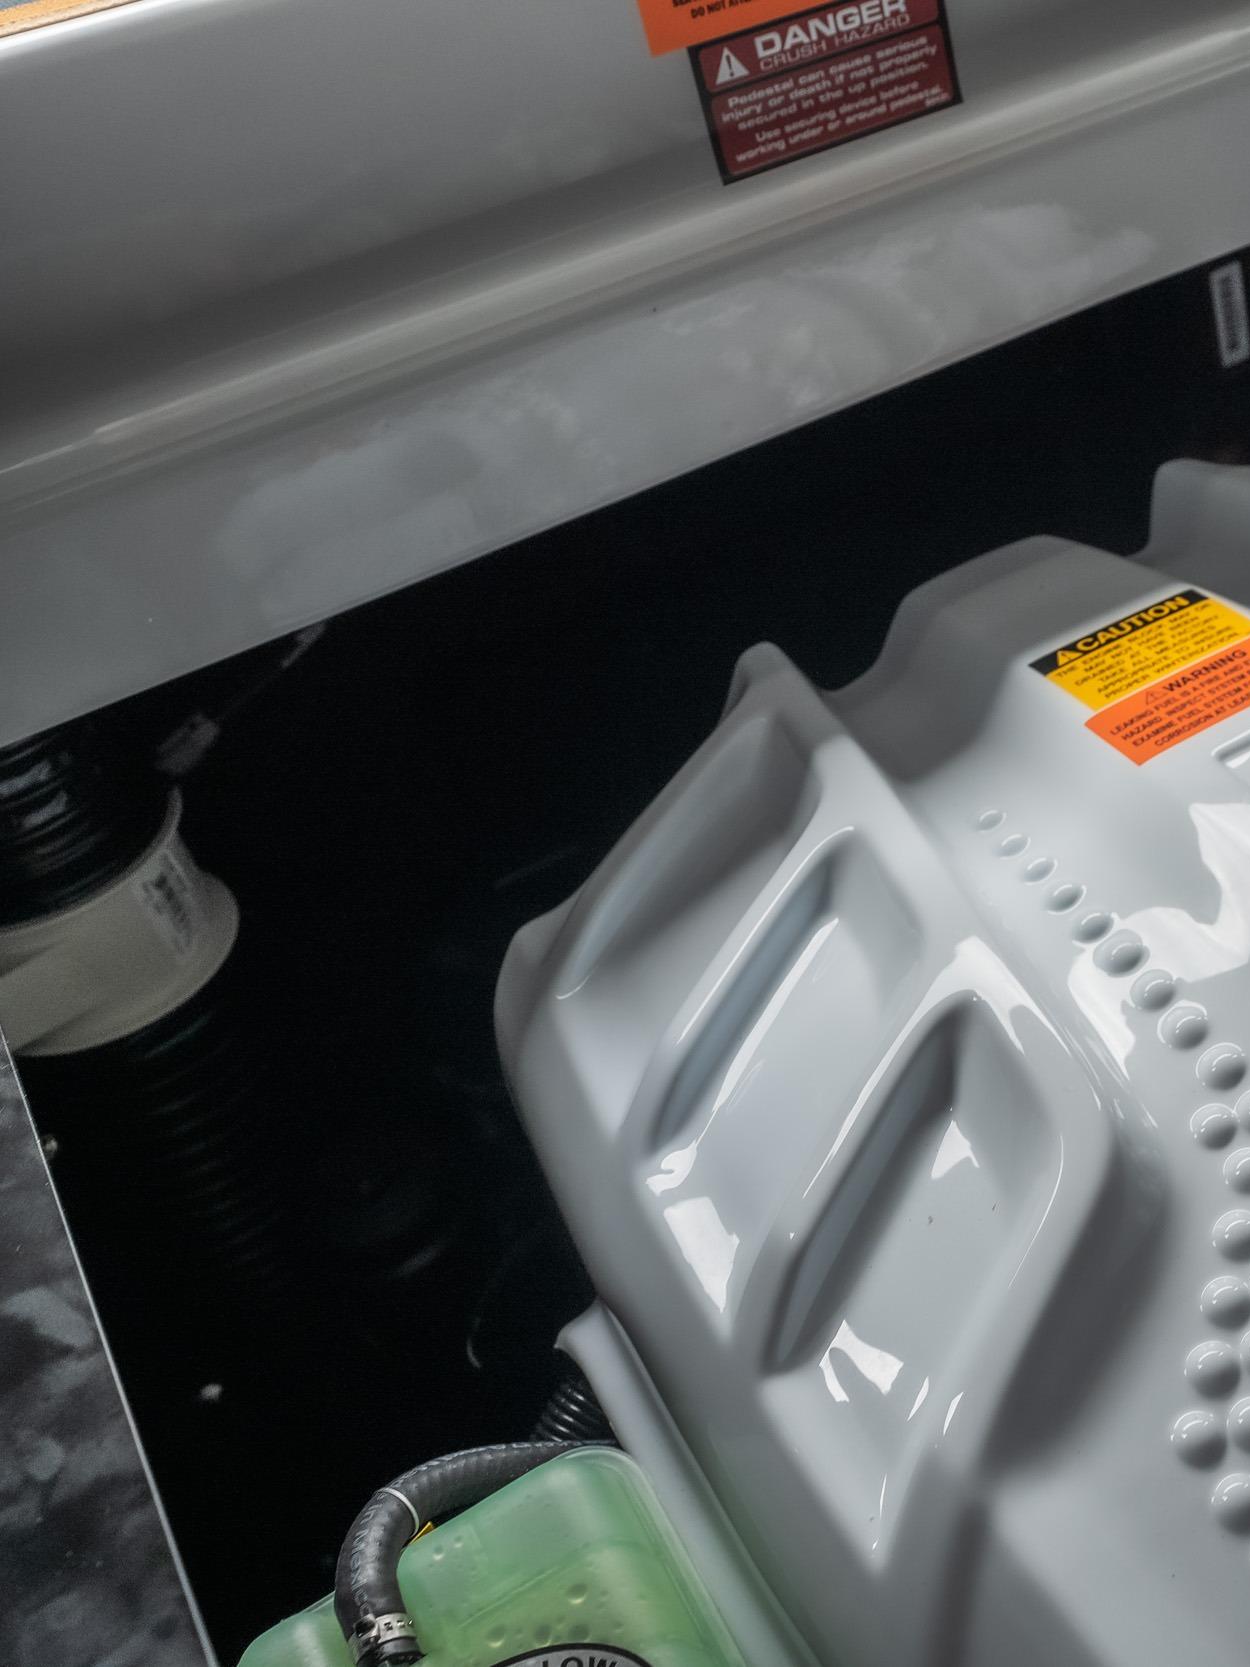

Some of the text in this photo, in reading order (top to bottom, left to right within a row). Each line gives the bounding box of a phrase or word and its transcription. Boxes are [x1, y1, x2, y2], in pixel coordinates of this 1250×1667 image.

[691, 7, 705, 18] DO
[706, 0, 726, 14] NOT
[753, 0, 906, 60] DANGER
[759, 11, 910, 72] CRUSH HAZARD
[721, 43, 937, 124] injury or death if not properly
[727, 34, 927, 109] Pedestal can cause serious
[737, 59, 928, 131] secured in the up position.
[735, 138, 785, 164] working
[788, 125, 823, 144] under
[827, 119, 841, 131] or
[845, 103, 886, 125] around
[889, 84, 941, 110] pedestal.
[755, 126, 780, 142] Use
[784, 107, 836, 134] securing
[838, 93, 876, 114] device
[879, 79, 919, 101] before
[1074, 595, 1190, 652] CAUTION
[1083, 659, 1107, 672] MAY
[1137, 631, 1165, 646] HAVE
[1073, 659, 1126, 685] DRAINED
[1099, 667, 1126, 681] TAKE
[1103, 673, 1151, 698] PROPER
[1109, 709, 1155, 734] LEAKING
[1153, 696, 1179, 710] FUEL
[1199, 675, 1221, 687] FIRE
[1222, 664, 1243, 676] AND
[1163, 648, 1248, 693] WARNING
[1165, 693, 1207, 716] INSPECT
[1207, 673, 1246, 694] SYSTEM
[1131, 720, 1177, 745] EXAMINE
[1176, 707, 1202, 722] FUEL
[1203, 686, 1243, 708] SYSTEM
[1153, 713, 1215, 746] CORROSION
[1212, 706, 1227, 715] AT
[542, 1656, 618, 1667] OW
